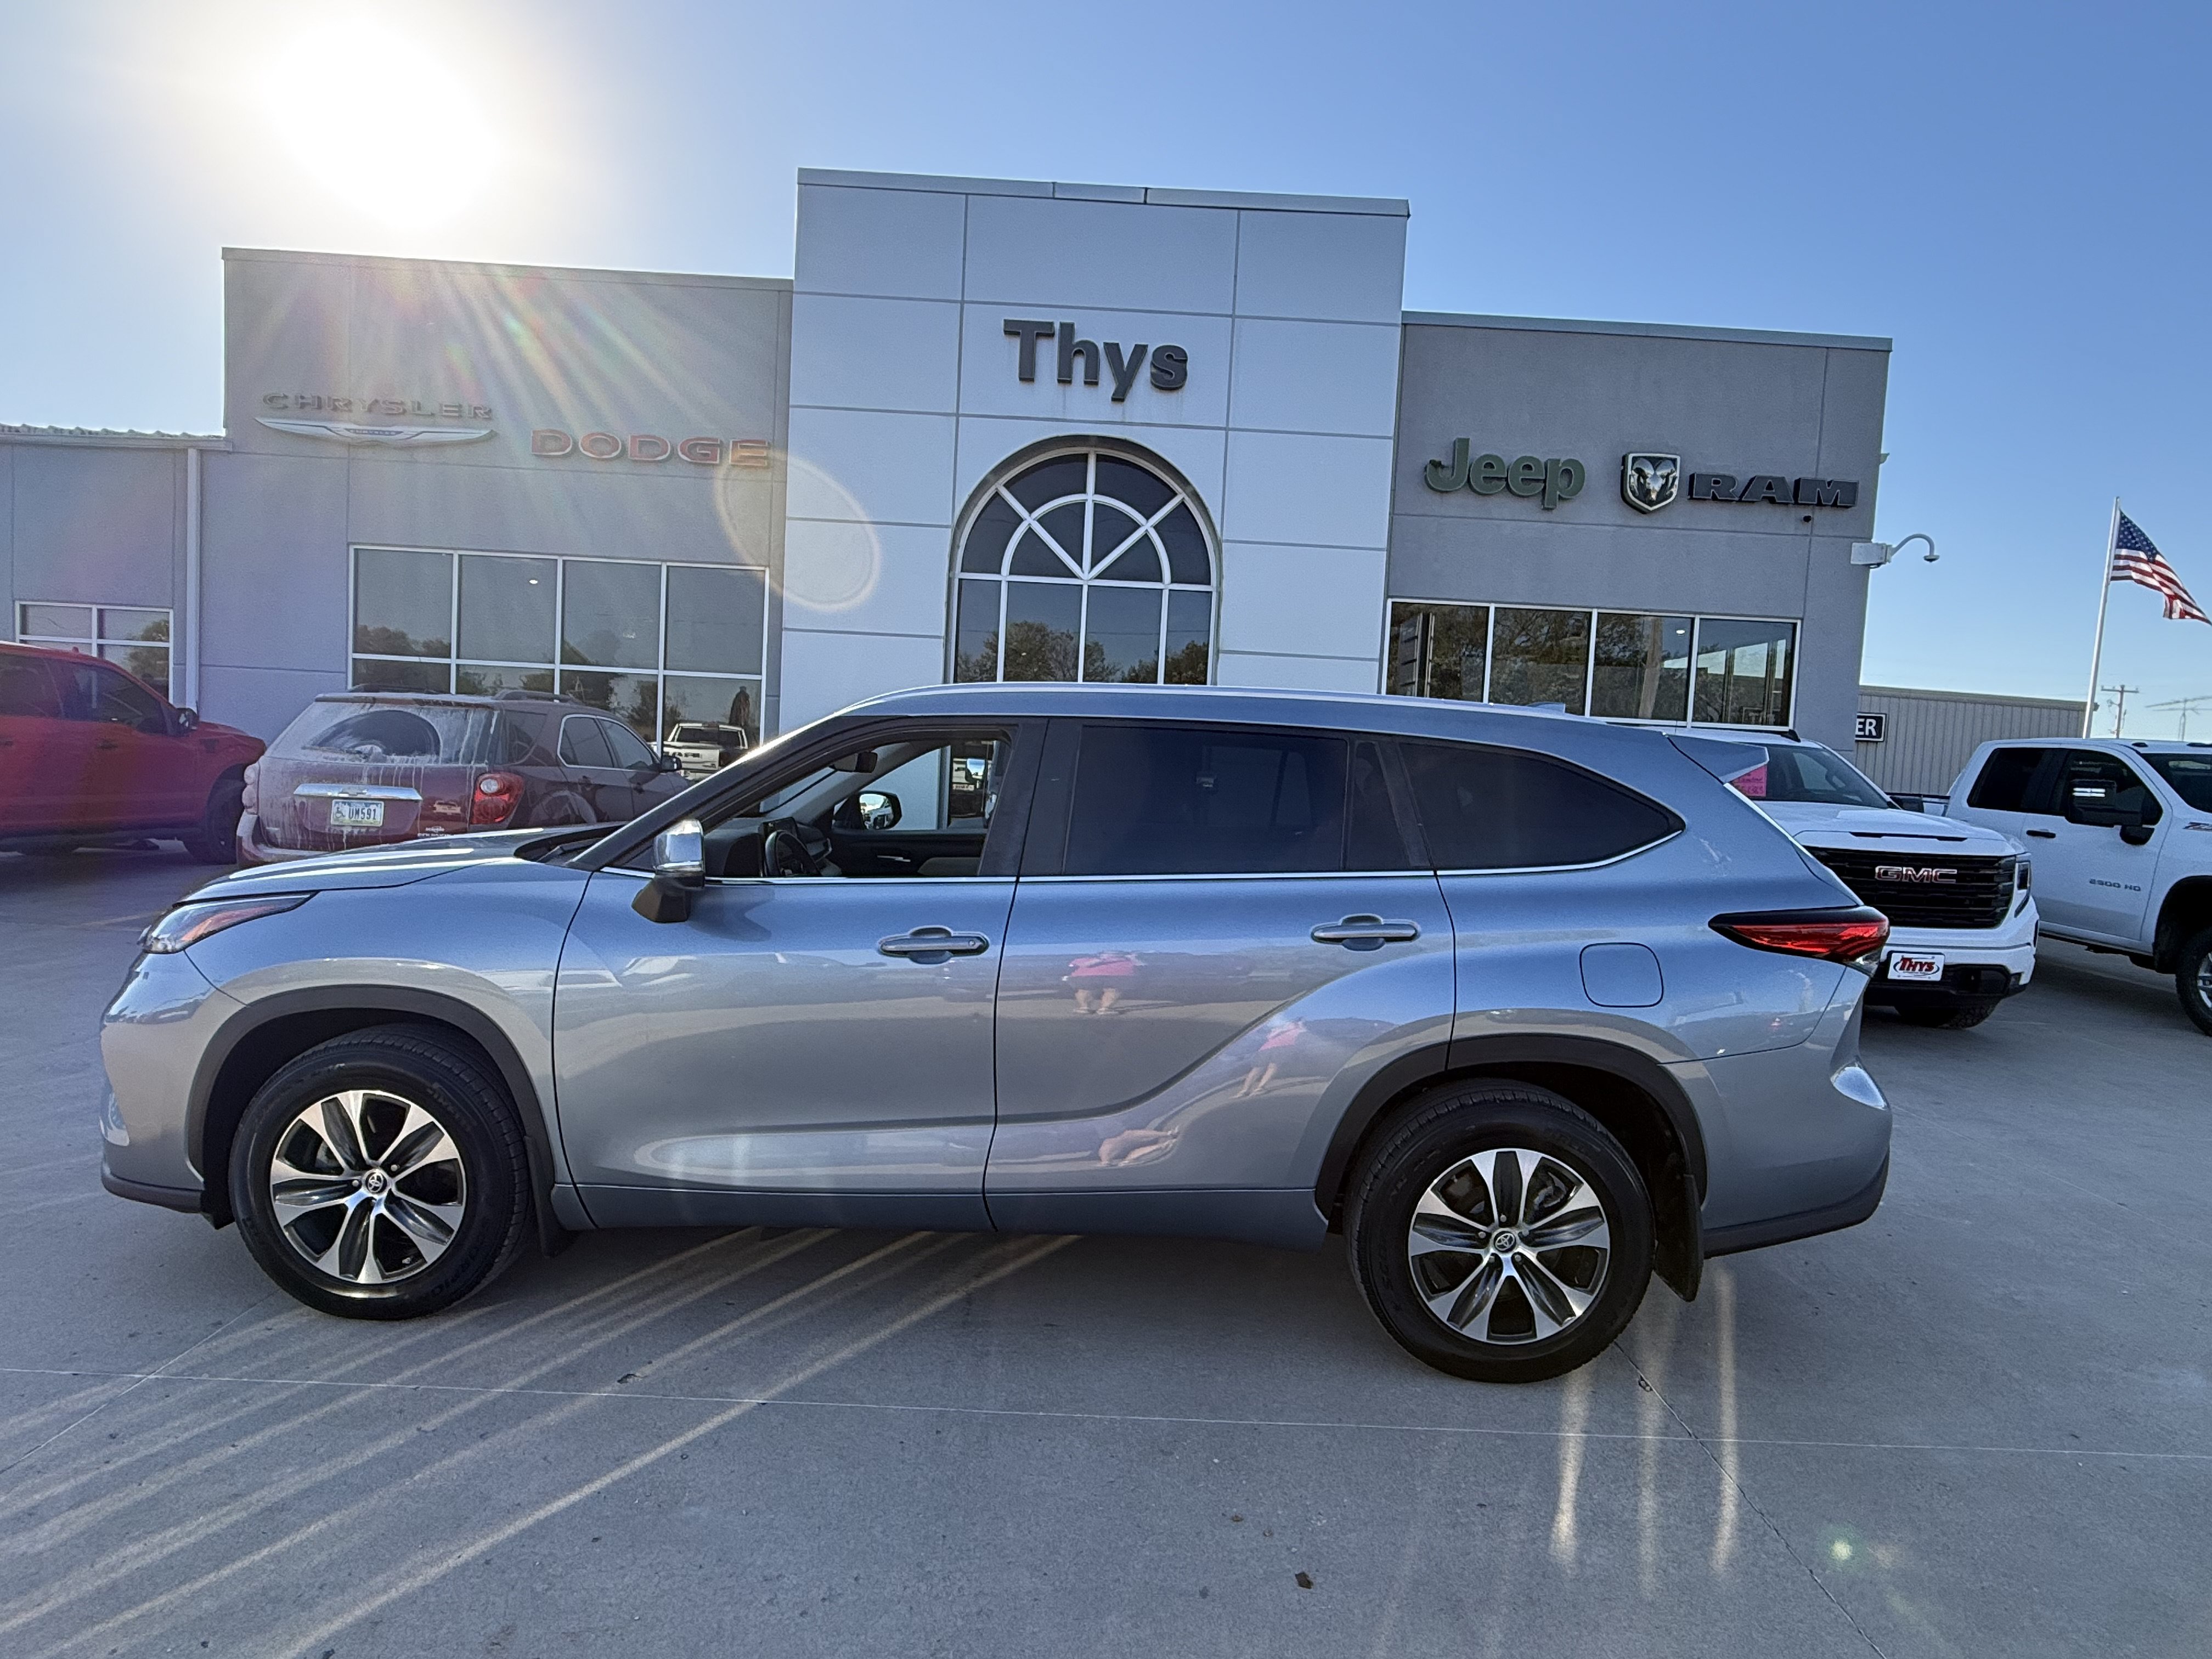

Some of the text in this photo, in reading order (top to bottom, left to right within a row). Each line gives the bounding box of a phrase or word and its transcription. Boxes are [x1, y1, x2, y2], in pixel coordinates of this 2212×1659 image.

[1003, 318, 1189, 402] Thys
[262, 392, 493, 419] CHRYSLER
[531, 428, 769, 467] DODGE
[1424, 437, 1585, 510] Jeep
[1688, 472, 1859, 508] RAM
[1875, 865, 1957, 884] GMC
[1898, 957, 1936, 972] THYS
